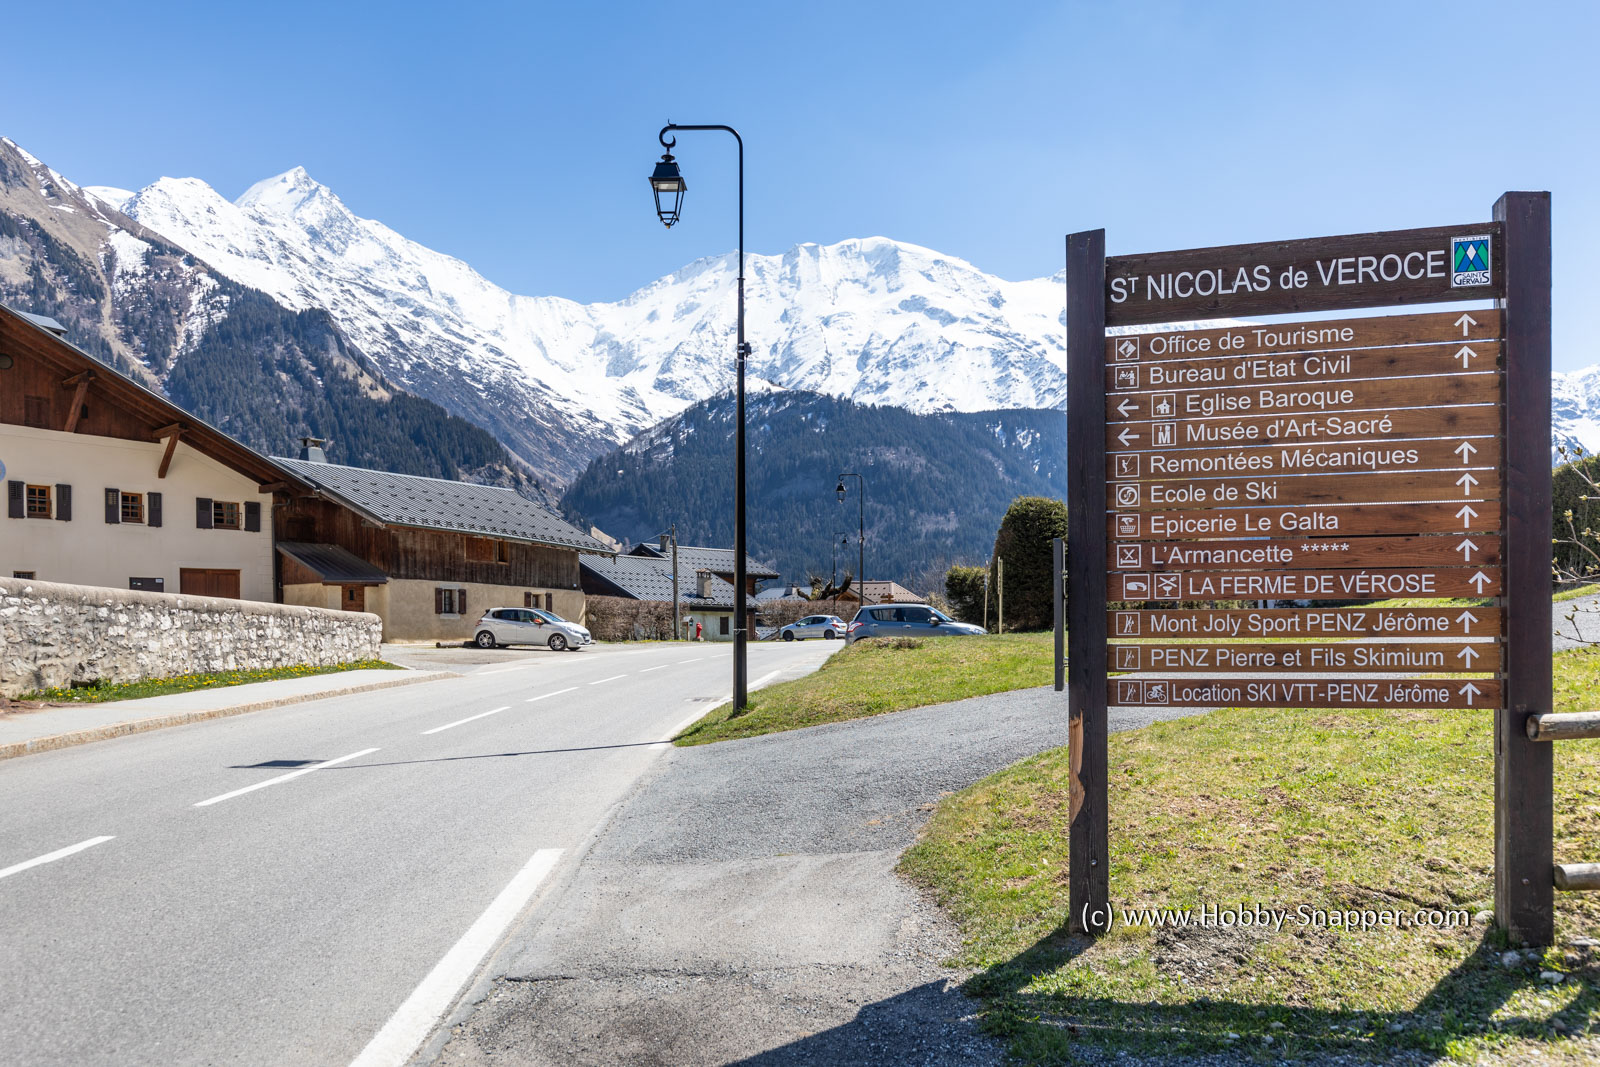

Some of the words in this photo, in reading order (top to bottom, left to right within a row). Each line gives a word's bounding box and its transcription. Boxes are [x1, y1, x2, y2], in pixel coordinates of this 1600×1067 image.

[1147, 264, 1271, 301] NICOLAS
[1279, 265, 1309, 290] de
[1315, 249, 1446, 286] VEROCE
[1462, 271, 1482, 279] SAINT
[1149, 335, 1211, 355] Office
[1218, 331, 1245, 351] de
[1251, 326, 1354, 348] Tourisme
[1149, 366, 1226, 385] Bureau
[1233, 359, 1297, 380] d'Etat
[1303, 354, 1351, 376] Civil
[1186, 392, 1252, 417] Eglise
[1259, 389, 1354, 410] Baroque
[1186, 421, 1259, 442] Musée
[1266, 414, 1393, 439] d'Art-Sacré
[1150, 451, 1274, 474] Remontées
[1281, 446, 1419, 470] Mécaniques
[1150, 484, 1207, 503] Ecole
[1212, 483, 1239, 502] de
[1245, 481, 1277, 500] Ski
[1150, 513, 1237, 538] Epicerie
[1245, 513, 1272, 532] Le
[1279, 511, 1339, 531] Galta
[1189, 576, 1216, 595] LA
[1220, 575, 1297, 595] FERME
[1304, 575, 1334, 594] DE
[1339, 570, 1436, 594] VÉROSE
[1150, 614, 1198, 633] Mont
[1203, 613, 1242, 637] Joly
[1247, 613, 1301, 636] Sport
[1306, 612, 1367, 632] PENZ
[1372, 612, 1450, 632] Jérôme
[1151, 648, 1209, 667] PENZ
[1216, 648, 1276, 667] Pierre
[1282, 649, 1302, 667] et
[1311, 647, 1346, 667] Fils
[1353, 647, 1444, 667] Skimium
[1172, 683, 1241, 702] Location
[1247, 683, 1276, 702] SKI
[1281, 683, 1379, 703] VTT-PENZ
[1383, 683, 1450, 703] Jérôme
